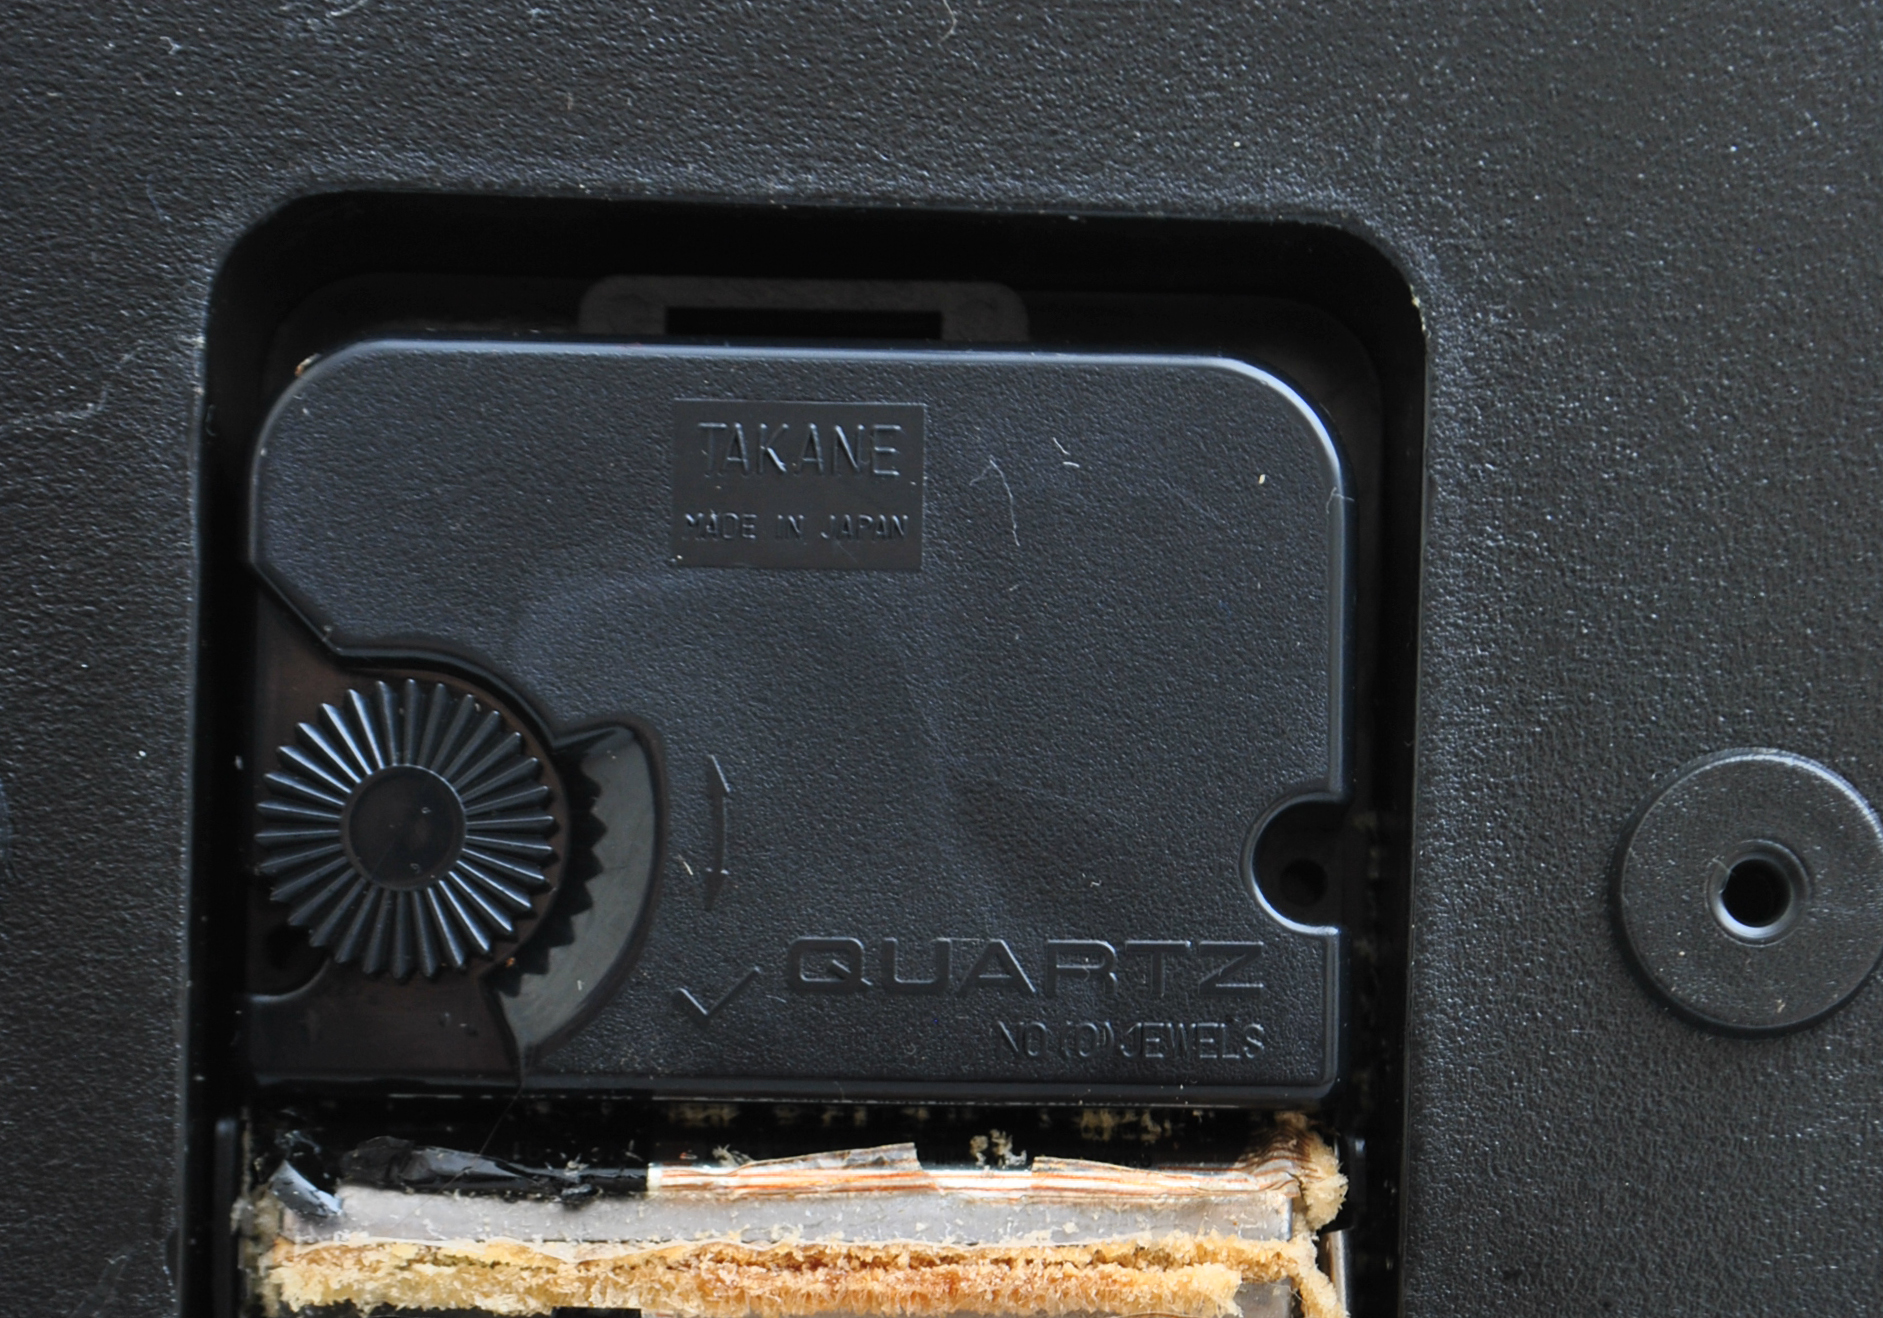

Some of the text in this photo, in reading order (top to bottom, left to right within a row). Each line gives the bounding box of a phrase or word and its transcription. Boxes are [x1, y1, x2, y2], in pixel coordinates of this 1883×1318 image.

[698, 421, 903, 478] TAKANE
[682, 510, 910, 542] MADE IN JAPAN
[786, 935, 1266, 998] QUARTZ
[994, 1019, 1048, 1060] NO
[1118, 1022, 1267, 1060] JEWELS
